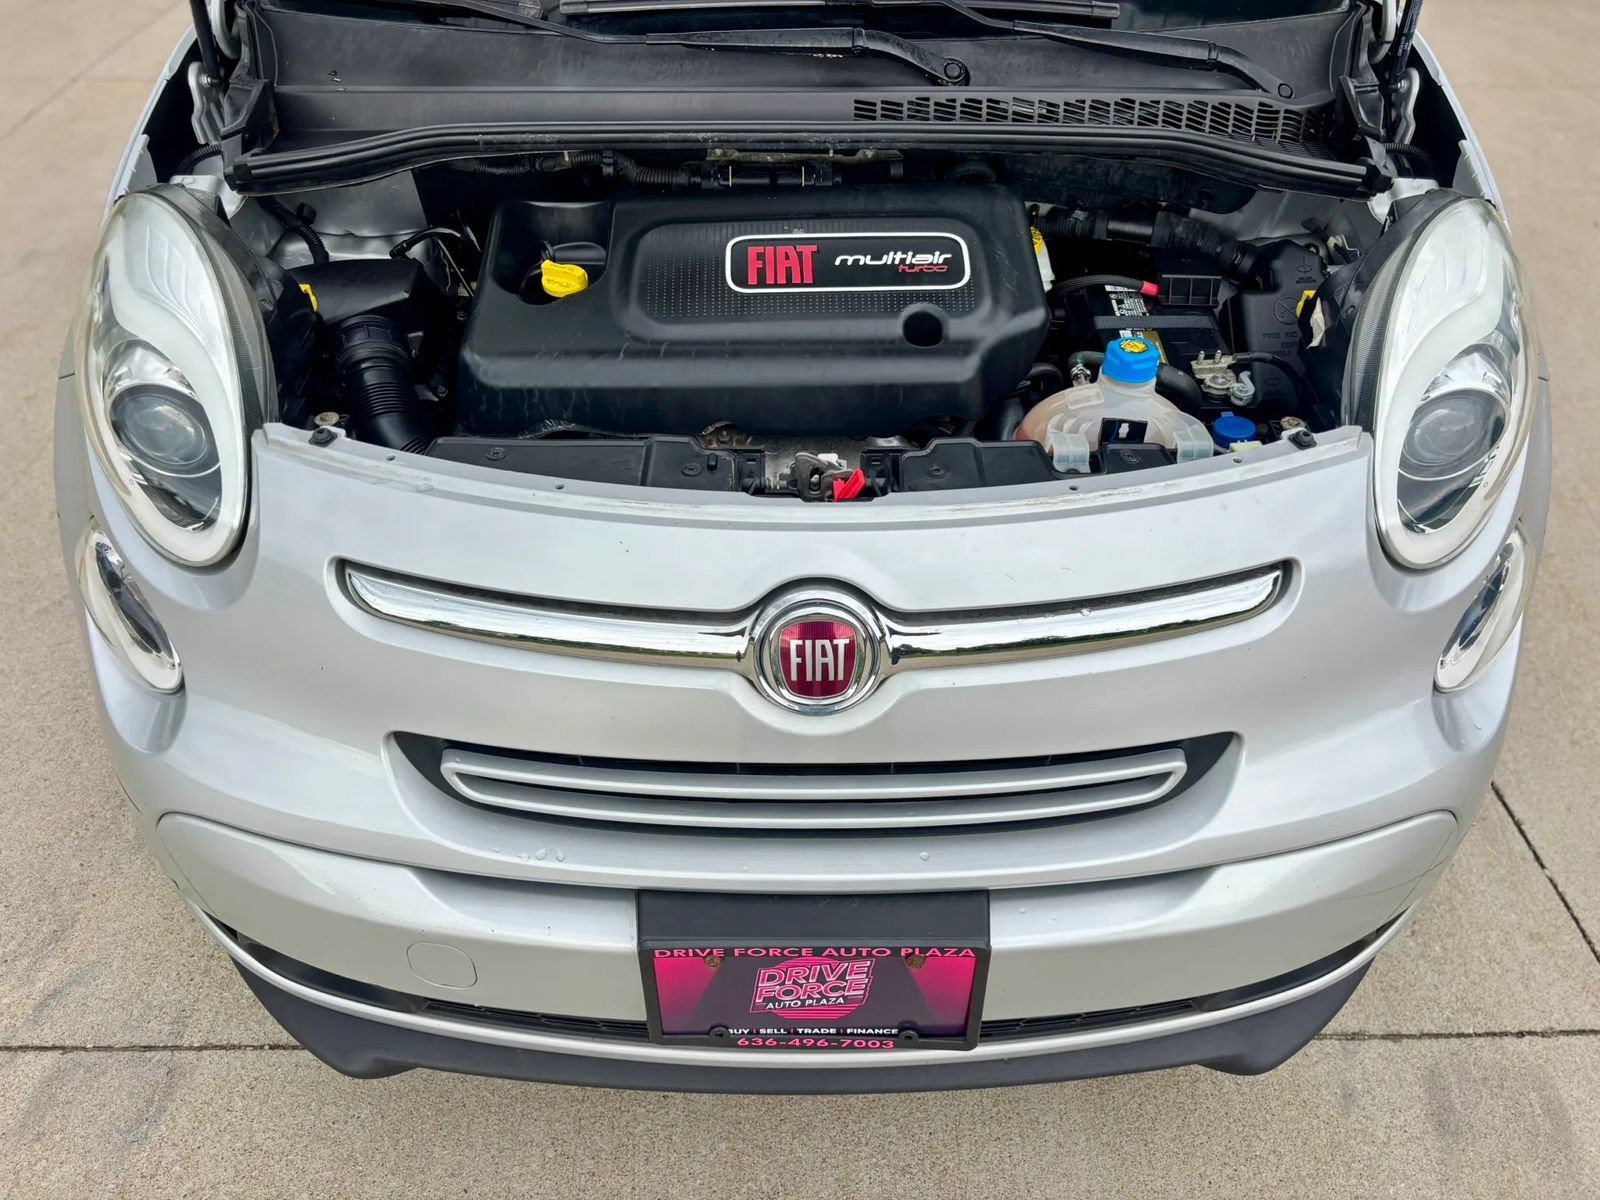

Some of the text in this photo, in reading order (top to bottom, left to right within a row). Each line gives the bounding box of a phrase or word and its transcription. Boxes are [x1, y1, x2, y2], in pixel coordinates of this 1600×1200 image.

[747, 244, 818, 285] FIAT
[834, 250, 952, 266] multiair
[897, 264, 949, 273] turbo
[788, 638, 850, 682] FIAT
[654, 947, 976, 958] DRIVE FORCE AUTO PLAZA
[758, 960, 871, 987] DRIVE
[755, 978, 869, 1003] FORCE
[765, 997, 845, 1010] AUTO PLAZA
[737, 1037, 896, 1049] 636-496-7003
